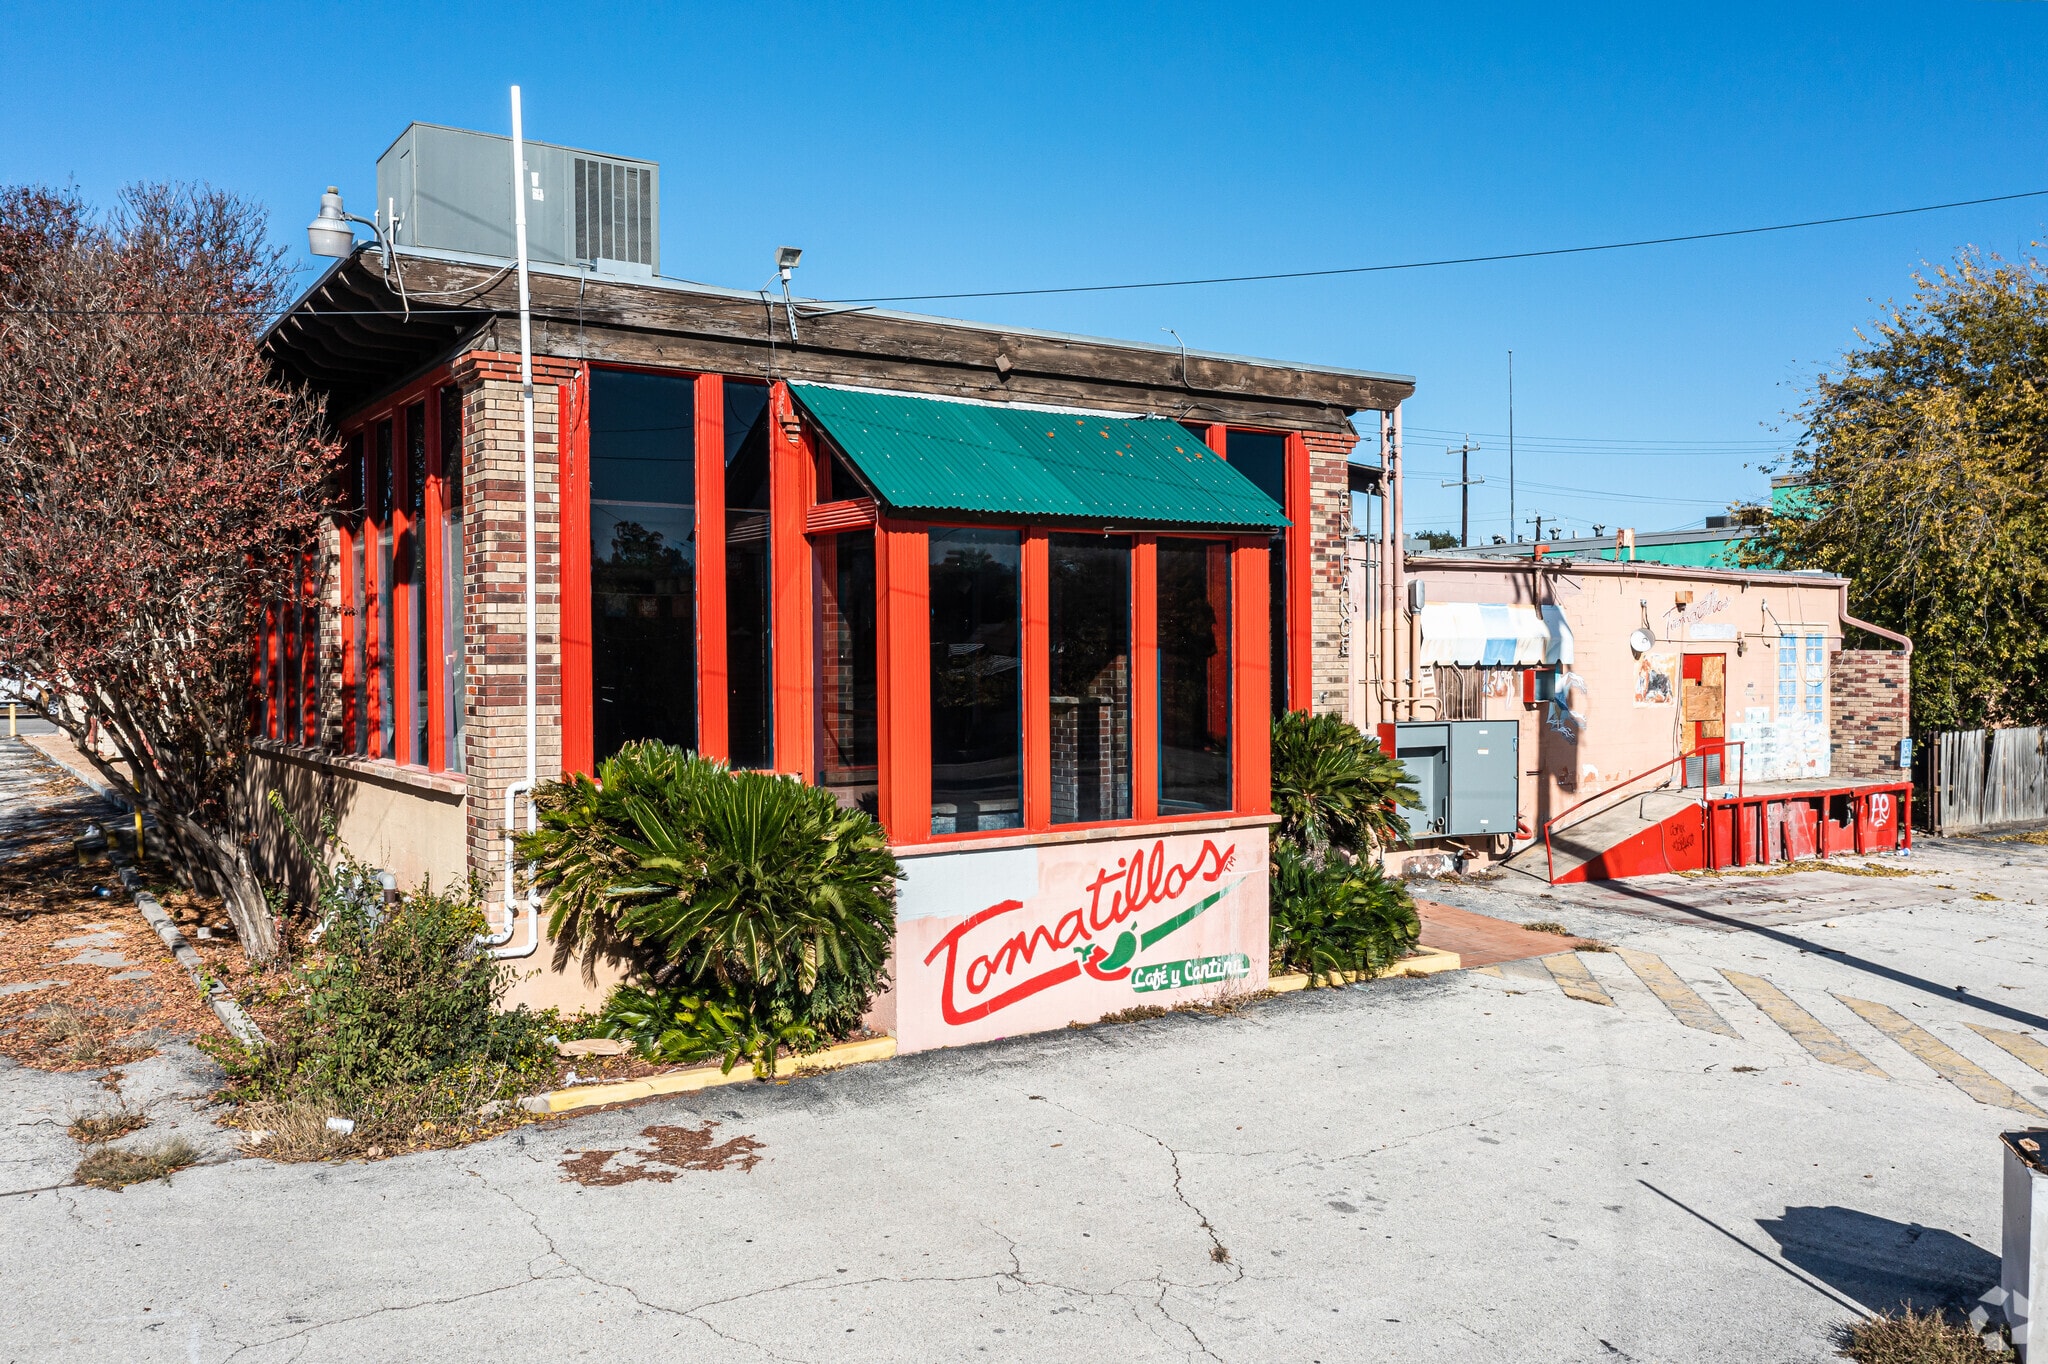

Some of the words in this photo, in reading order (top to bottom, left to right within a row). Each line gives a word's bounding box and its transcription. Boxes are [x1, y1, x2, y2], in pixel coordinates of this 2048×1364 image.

[1224, 856, 1236, 872] TM
[924, 840, 1235, 1025] Tomatillos
[1132, 964, 1168, 990] Café
[1170, 970, 1181, 988] y
